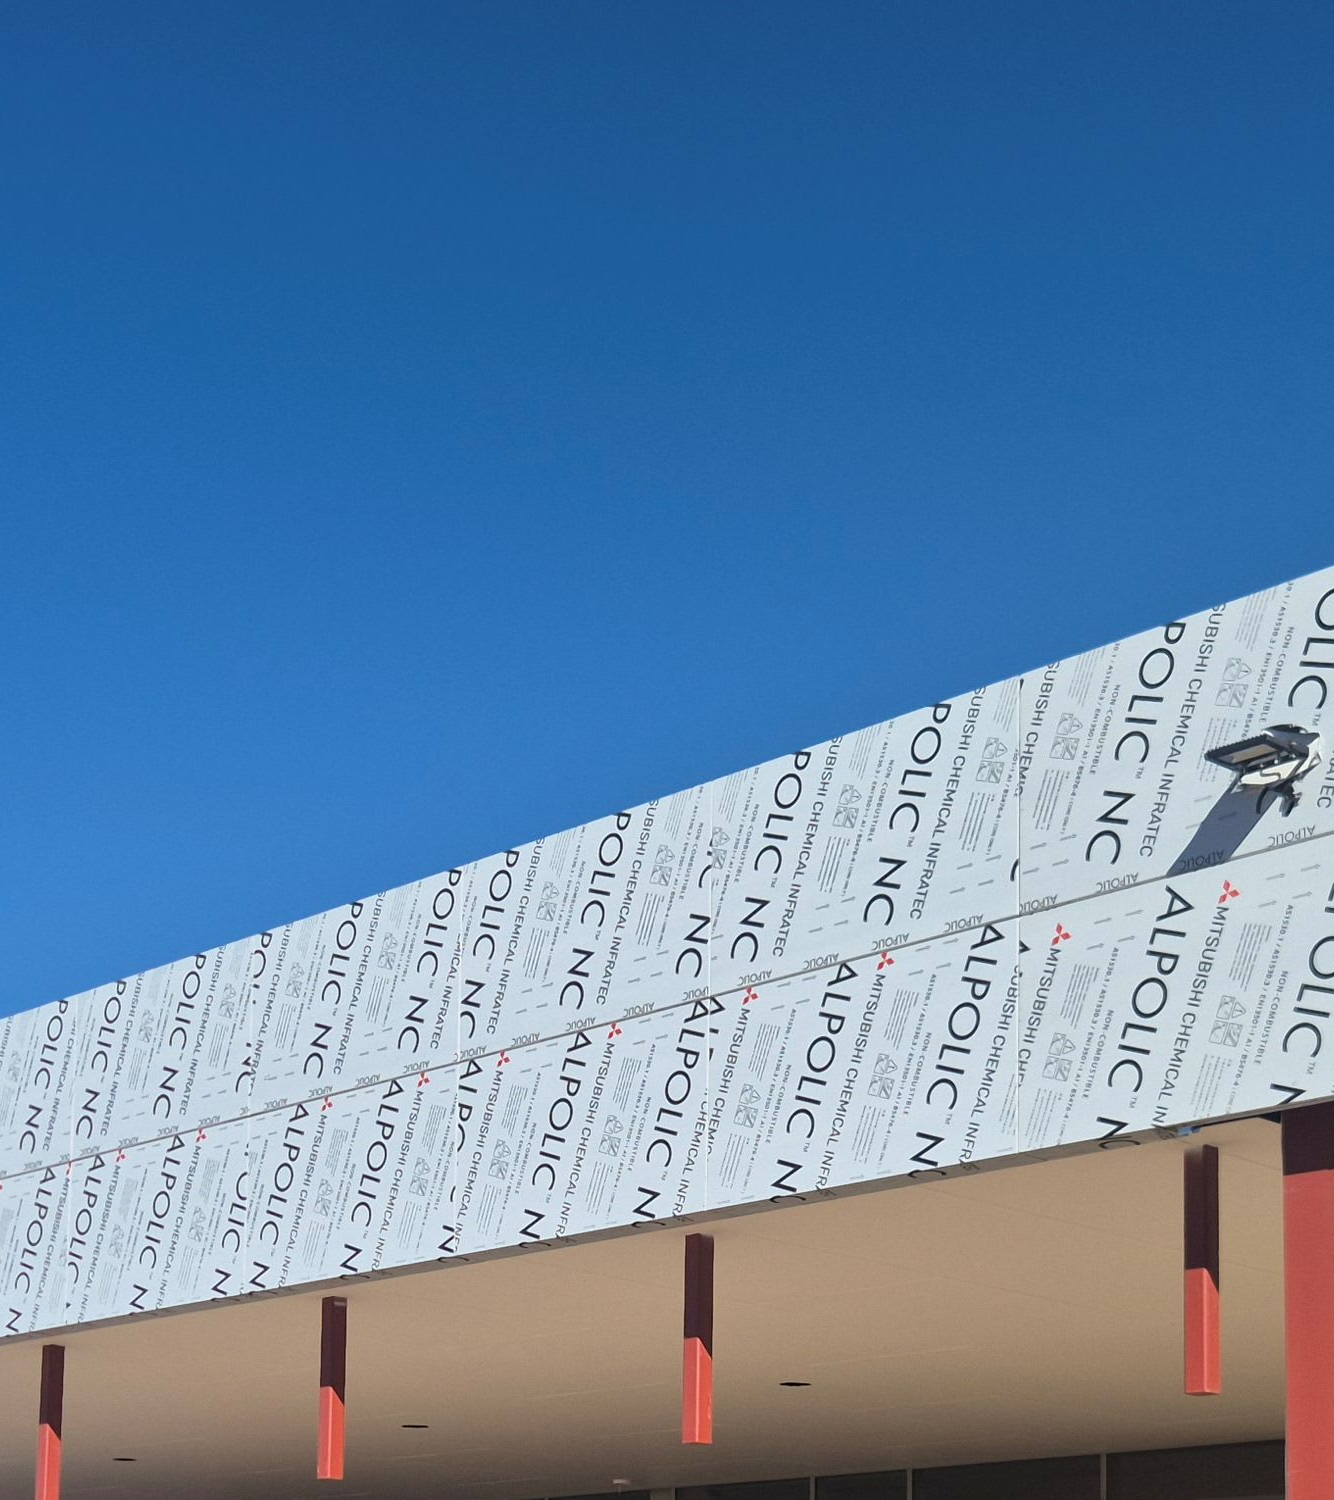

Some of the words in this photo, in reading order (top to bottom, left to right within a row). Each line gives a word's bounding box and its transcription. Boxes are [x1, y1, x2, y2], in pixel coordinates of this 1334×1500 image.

[1115, 622, 1186, 764] POLIC
[1164, 677, 1203, 769] CHEMICAL
[889, 703, 951, 832] POLIC
[931, 754, 966, 838] CHEMICAL
[754, 751, 811, 875] POLIC
[793, 801, 824, 881] CHEMICAL
[1086, 790, 1136, 865] NC
[1140, 774, 1175, 858] INFRATEC
[473, 851, 519, 960] POLIC
[581, 812, 631, 928] POLIC
[615, 860, 642, 933] CHEMICAL
[863, 856, 907, 926] NC
[910, 841, 942, 920] INFRATEC
[322, 902, 363, 1005] POLIC
[417, 869, 462, 976] POLIC
[503, 895, 529, 966] CHEMICAL
[676, 913, 711, 978] NC
[730, 897, 770, 963] NC
[773, 884, 801, 957] INFRATEC
[1191, 906, 1229, 1009] MITSUBISHI
[169, 954, 206, 1051] POLIC
[259, 974, 280, 1037] CHEMICAL
[349, 945, 372, 1011] CHEMICAL
[487, 970, 511, 1035] INFRATEC
[559, 948, 595, 1010] NC
[597, 937, 622, 1005] INFRATEC
[1027, 948, 1061, 1044] MITSUBISHI
[1108, 885, 1195, 1093] ALPOLIC
[35, 1000, 68, 1089] POLIC
[92, 980, 127, 1073] POLIC
[193, 995, 213, 1055] CHEMICAL
[334, 1013, 355, 1074] INFRATEC
[398, 995, 429, 1053] NC
[429, 986, 452, 1049] INFRATEC
[460, 979, 486, 1039] NC
[851, 974, 886, 1064] MITSUBISHI
[926, 924, 1005, 1110] ALPOLIC
[115, 1020, 133, 1076] CHEMICAL
[304, 1023, 333, 1079] NC
[585, 1042, 614, 1126] MITSUBISHI
[646, 1000, 708, 1167] ALPOLIC
[716, 1008, 751, 1094] MITSUBISHI
[787, 963, 858, 1139] ALPOLIC
[1157, 1011, 1197, 1110] CHEMICAL
[43, 1098, 60, 1151] INFRATEC
[76, 1088, 101, 1139] NC
[100, 1082, 119, 1137] INFRATEC
[153, 1066, 179, 1119] NC
[179, 1059, 199, 1116] INFRATEC
[475, 1070, 503, 1149] MITSUBISHI
[532, 1031, 592, 1191] ALPOLIC
[825, 1068, 858, 1146] CHEMICAL
[20, 1105, 42, 1154] NC
[300, 1114, 327, 1187] MITSUBISHI
[352, 1080, 404, 1227] ALPOLIC
[395, 1091, 423, 1167] MITSUBISHI
[565, 1128, 591, 1198] CHEMICAL
[97, 1165, 121, 1232] MITSUBISHI
[140, 1135, 185, 1269] ALPOLIC
[176, 1145, 201, 1216] MITSUBISHI
[260, 1104, 309, 1246] ALPOLIC
[379, 1169, 403, 1234] CHEMICAL
[457, 1151, 482, 1220] CHEMICAL
[15, 1168, 56, 1294] ALPOLIC
[68, 1154, 105, 1284] ALPOLIC
[164, 1217, 183, 1276] CHEMICAL
[286, 1189, 308, 1253] CHEMICAL
[84, 1234, 104, 1292] CHEMICAL
